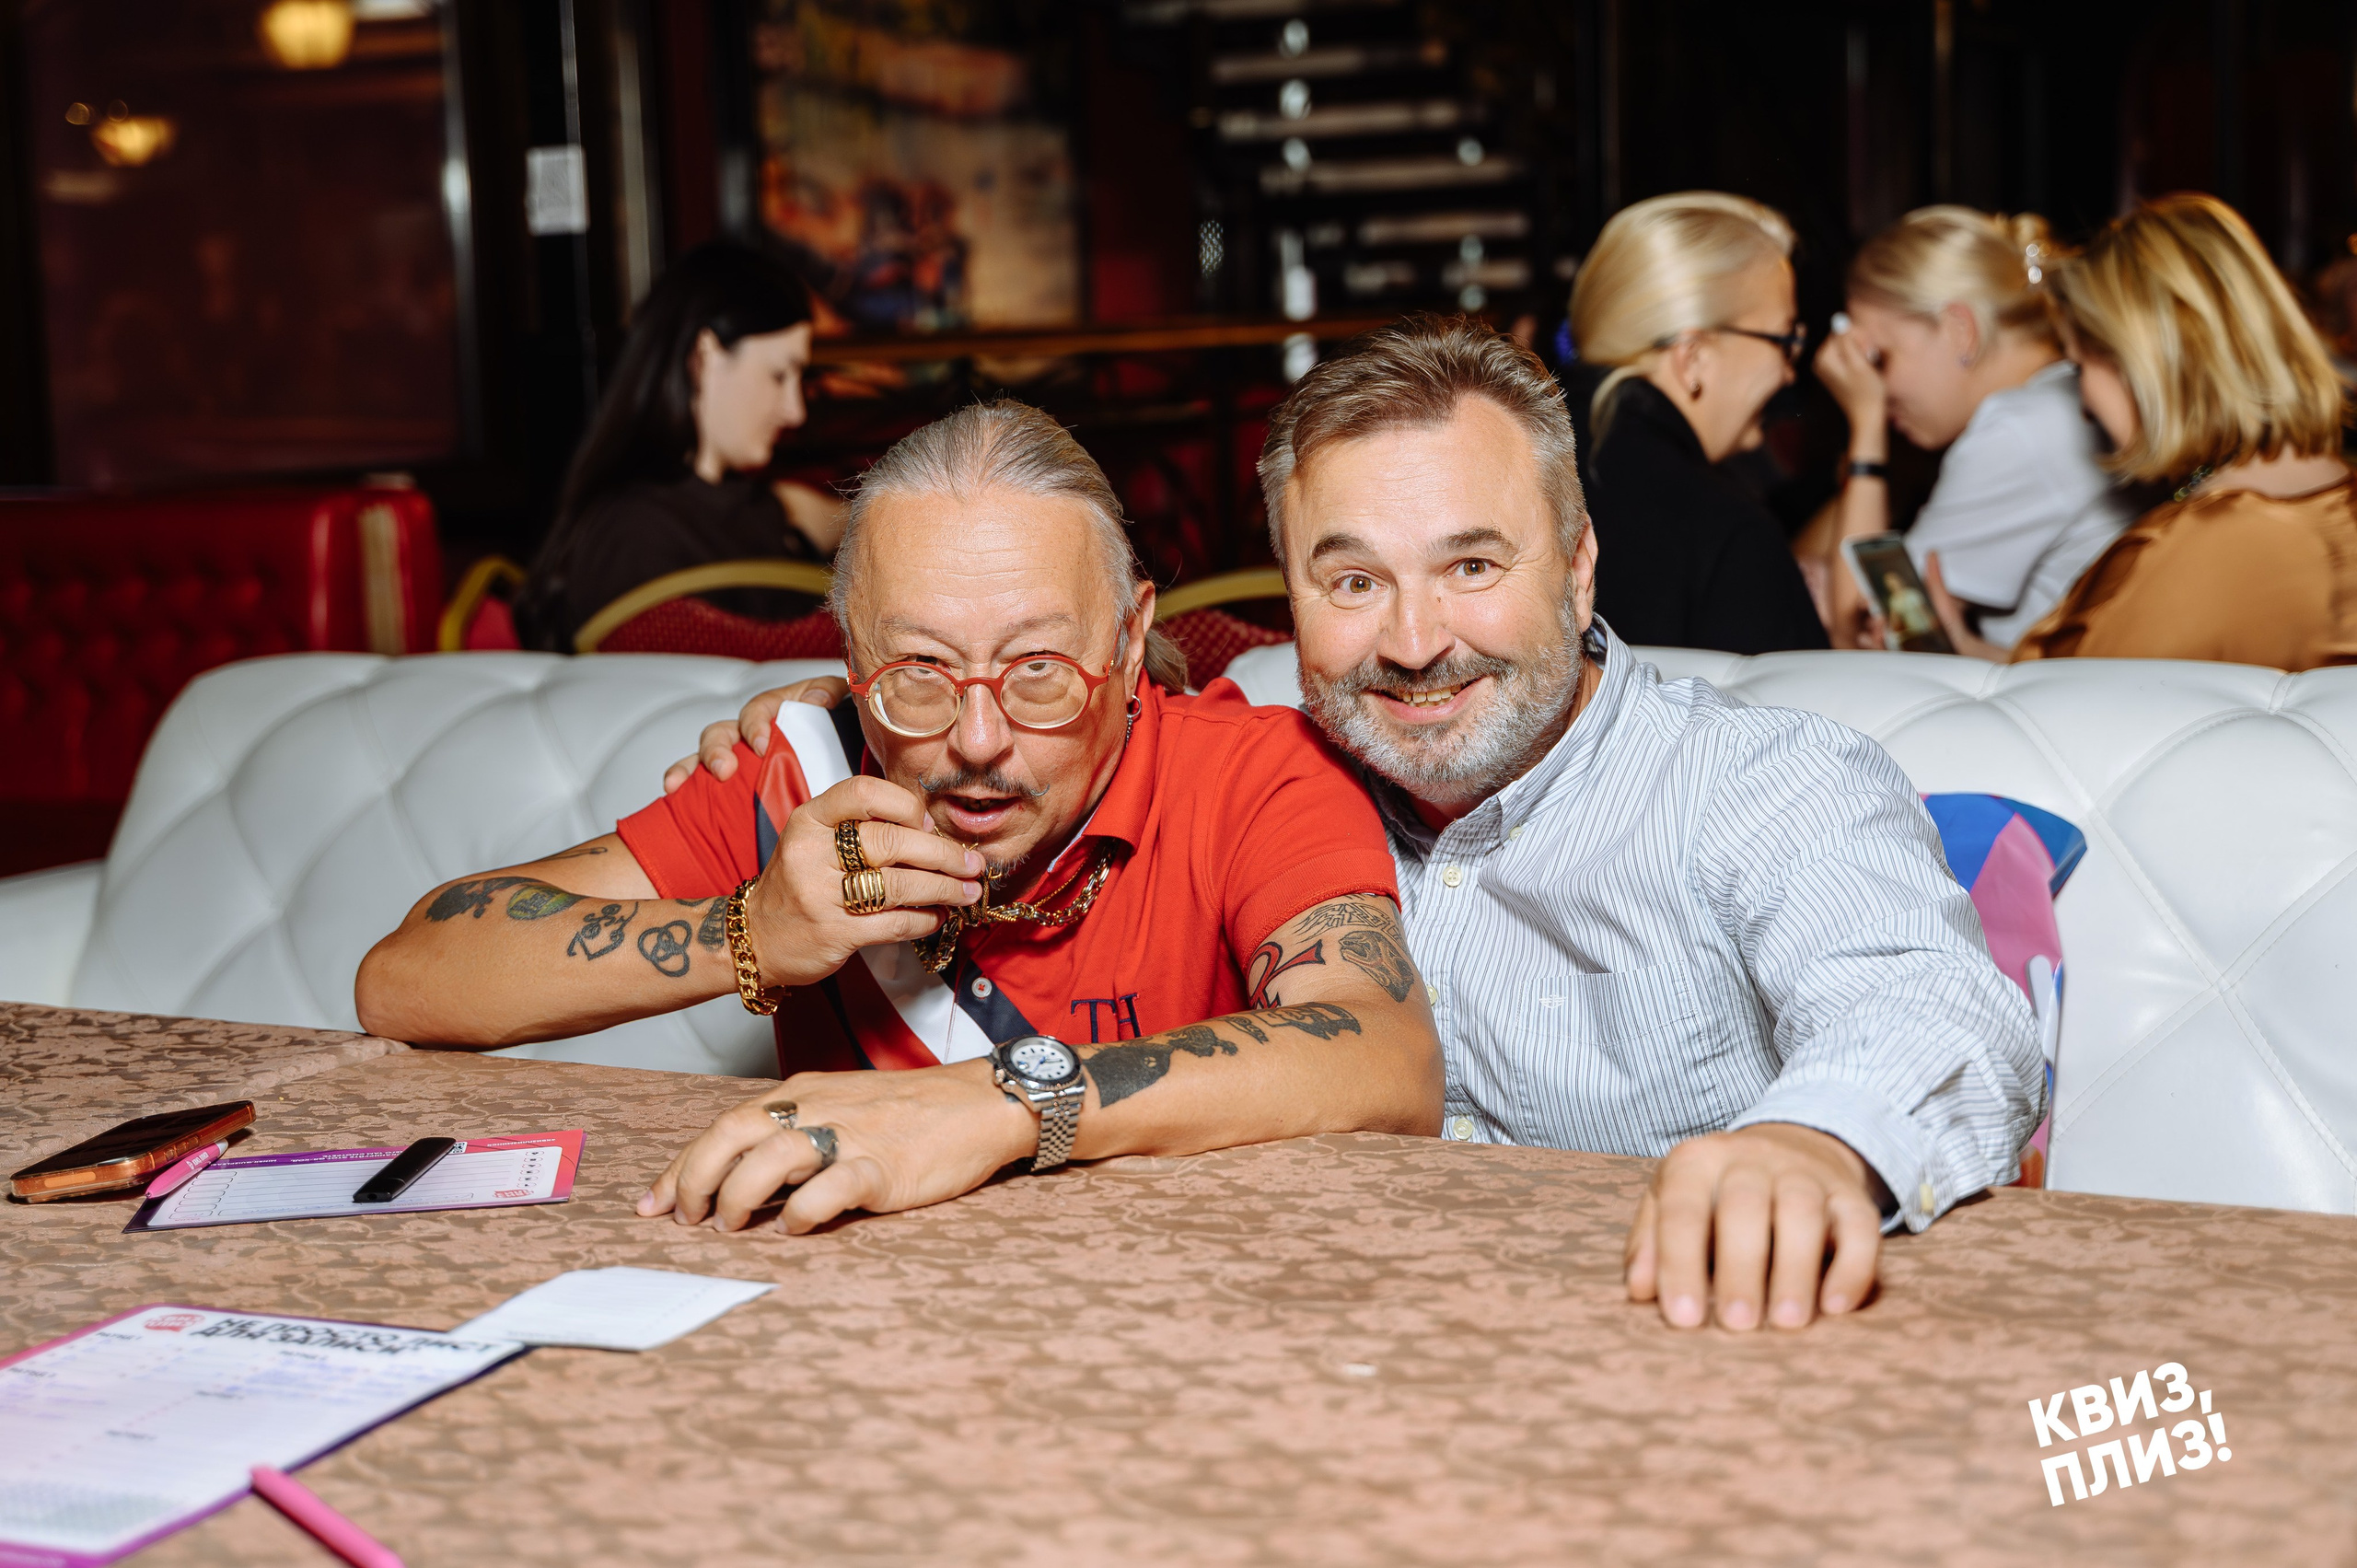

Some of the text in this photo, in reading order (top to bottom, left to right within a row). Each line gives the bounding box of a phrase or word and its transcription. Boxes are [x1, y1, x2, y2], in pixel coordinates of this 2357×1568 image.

[190, 1326, 268, 1341] ДЛЯ
[214, 1318, 262, 1330] НЕ
[263, 1323, 400, 1342] ПРОСТО
